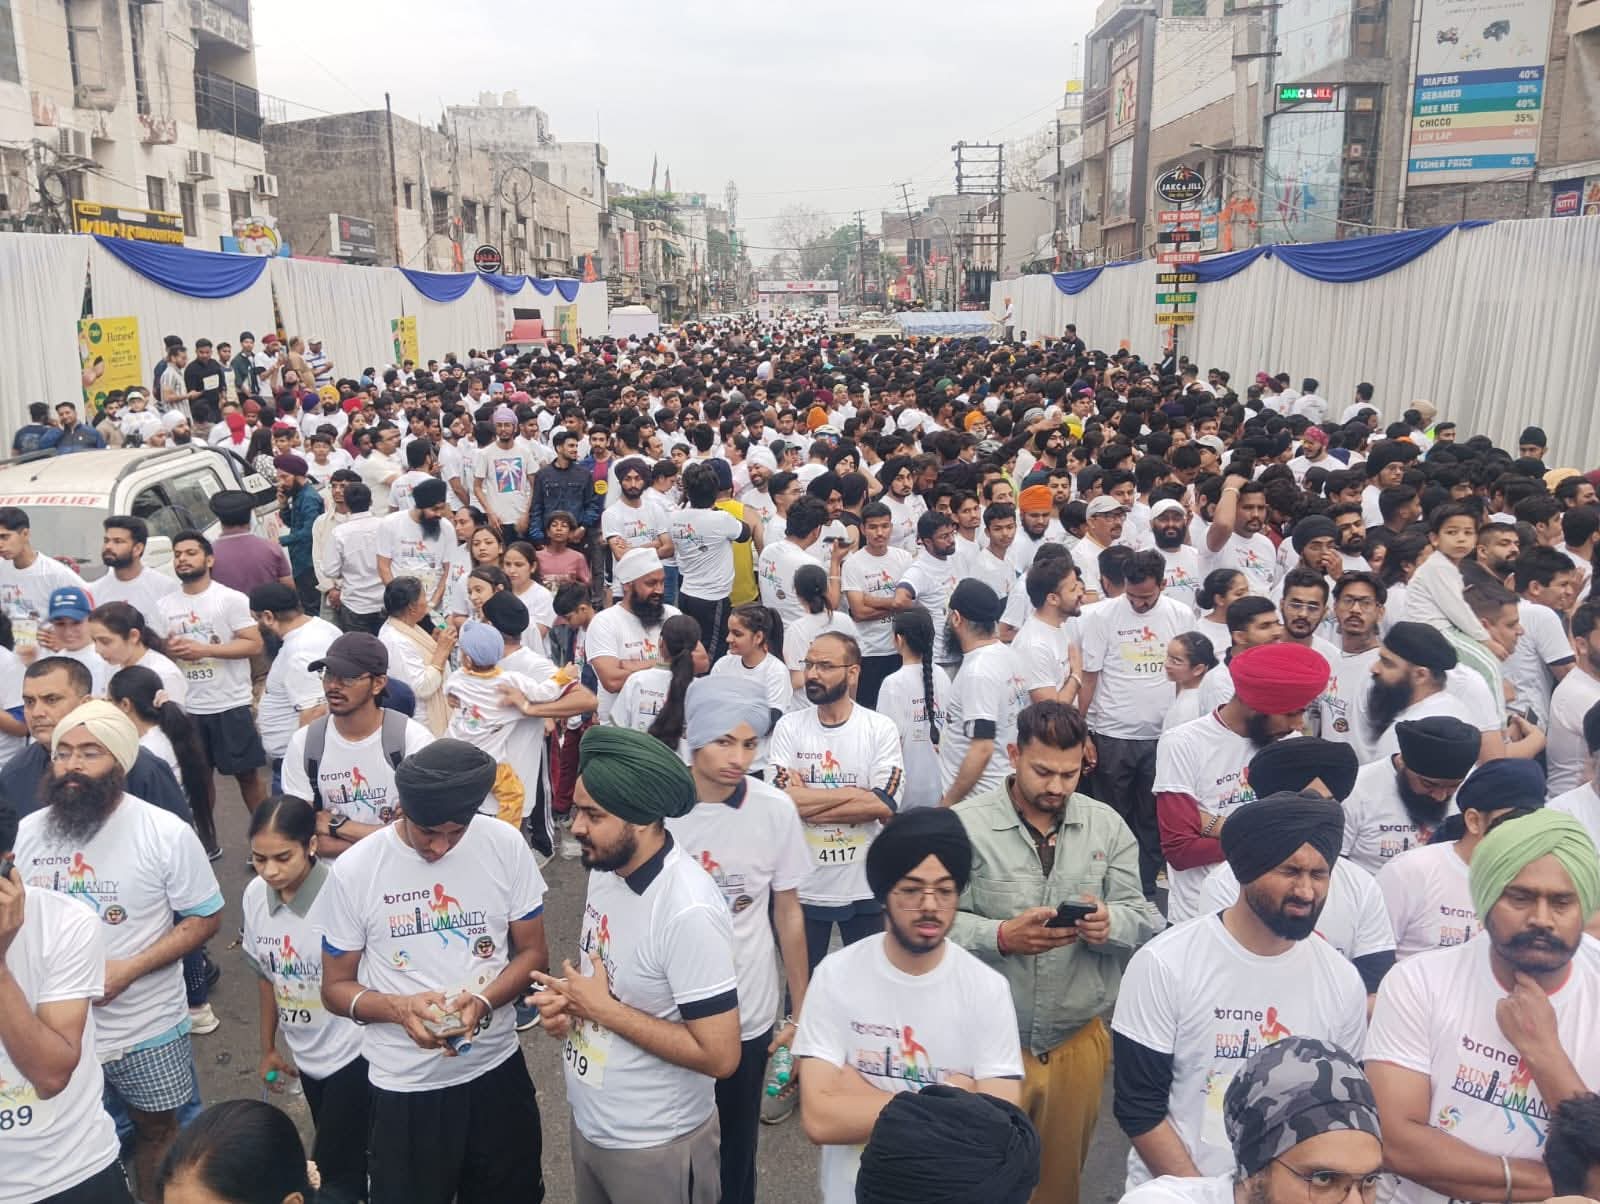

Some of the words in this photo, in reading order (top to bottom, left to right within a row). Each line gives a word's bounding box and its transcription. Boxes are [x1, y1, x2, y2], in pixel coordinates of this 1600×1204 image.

[1423, 75, 1459, 86] DIAPERS
[1519, 70, 1539, 79] 40%
[1313, 87, 1332, 98] JILL
[1422, 89, 1462, 100] SEBAMED
[1420, 104, 1439, 114] MEE
[1440, 103, 1460, 112] MEE
[1515, 99, 1536, 108] 40%
[1420, 118, 1452, 128] CHICCO
[1514, 113, 1535, 123] 35%
[1416, 159, 1446, 169] FISHER
[1447, 158, 1473, 168] PRICE
[1162, 183, 1181, 191] JAKC
[1187, 182, 1201, 190] JILL
[36, 495, 100, 506] RELIEF
[1135, 662, 1164, 672] 4107
[819, 847, 857, 862] 4117
[389, 913, 417, 929] RUN
[391, 922, 416, 937] FOR
[422, 911, 487, 932] HUMANITY
[467, 926, 487, 936] 2026
[1216, 1034, 1243, 1047] RUN
[1216, 1046, 1239, 1058] FOR
[1457, 1064, 1491, 1086] RUN
[1453, 1077, 1484, 1099] FOR
[0, 1109, 32, 1130] 89
